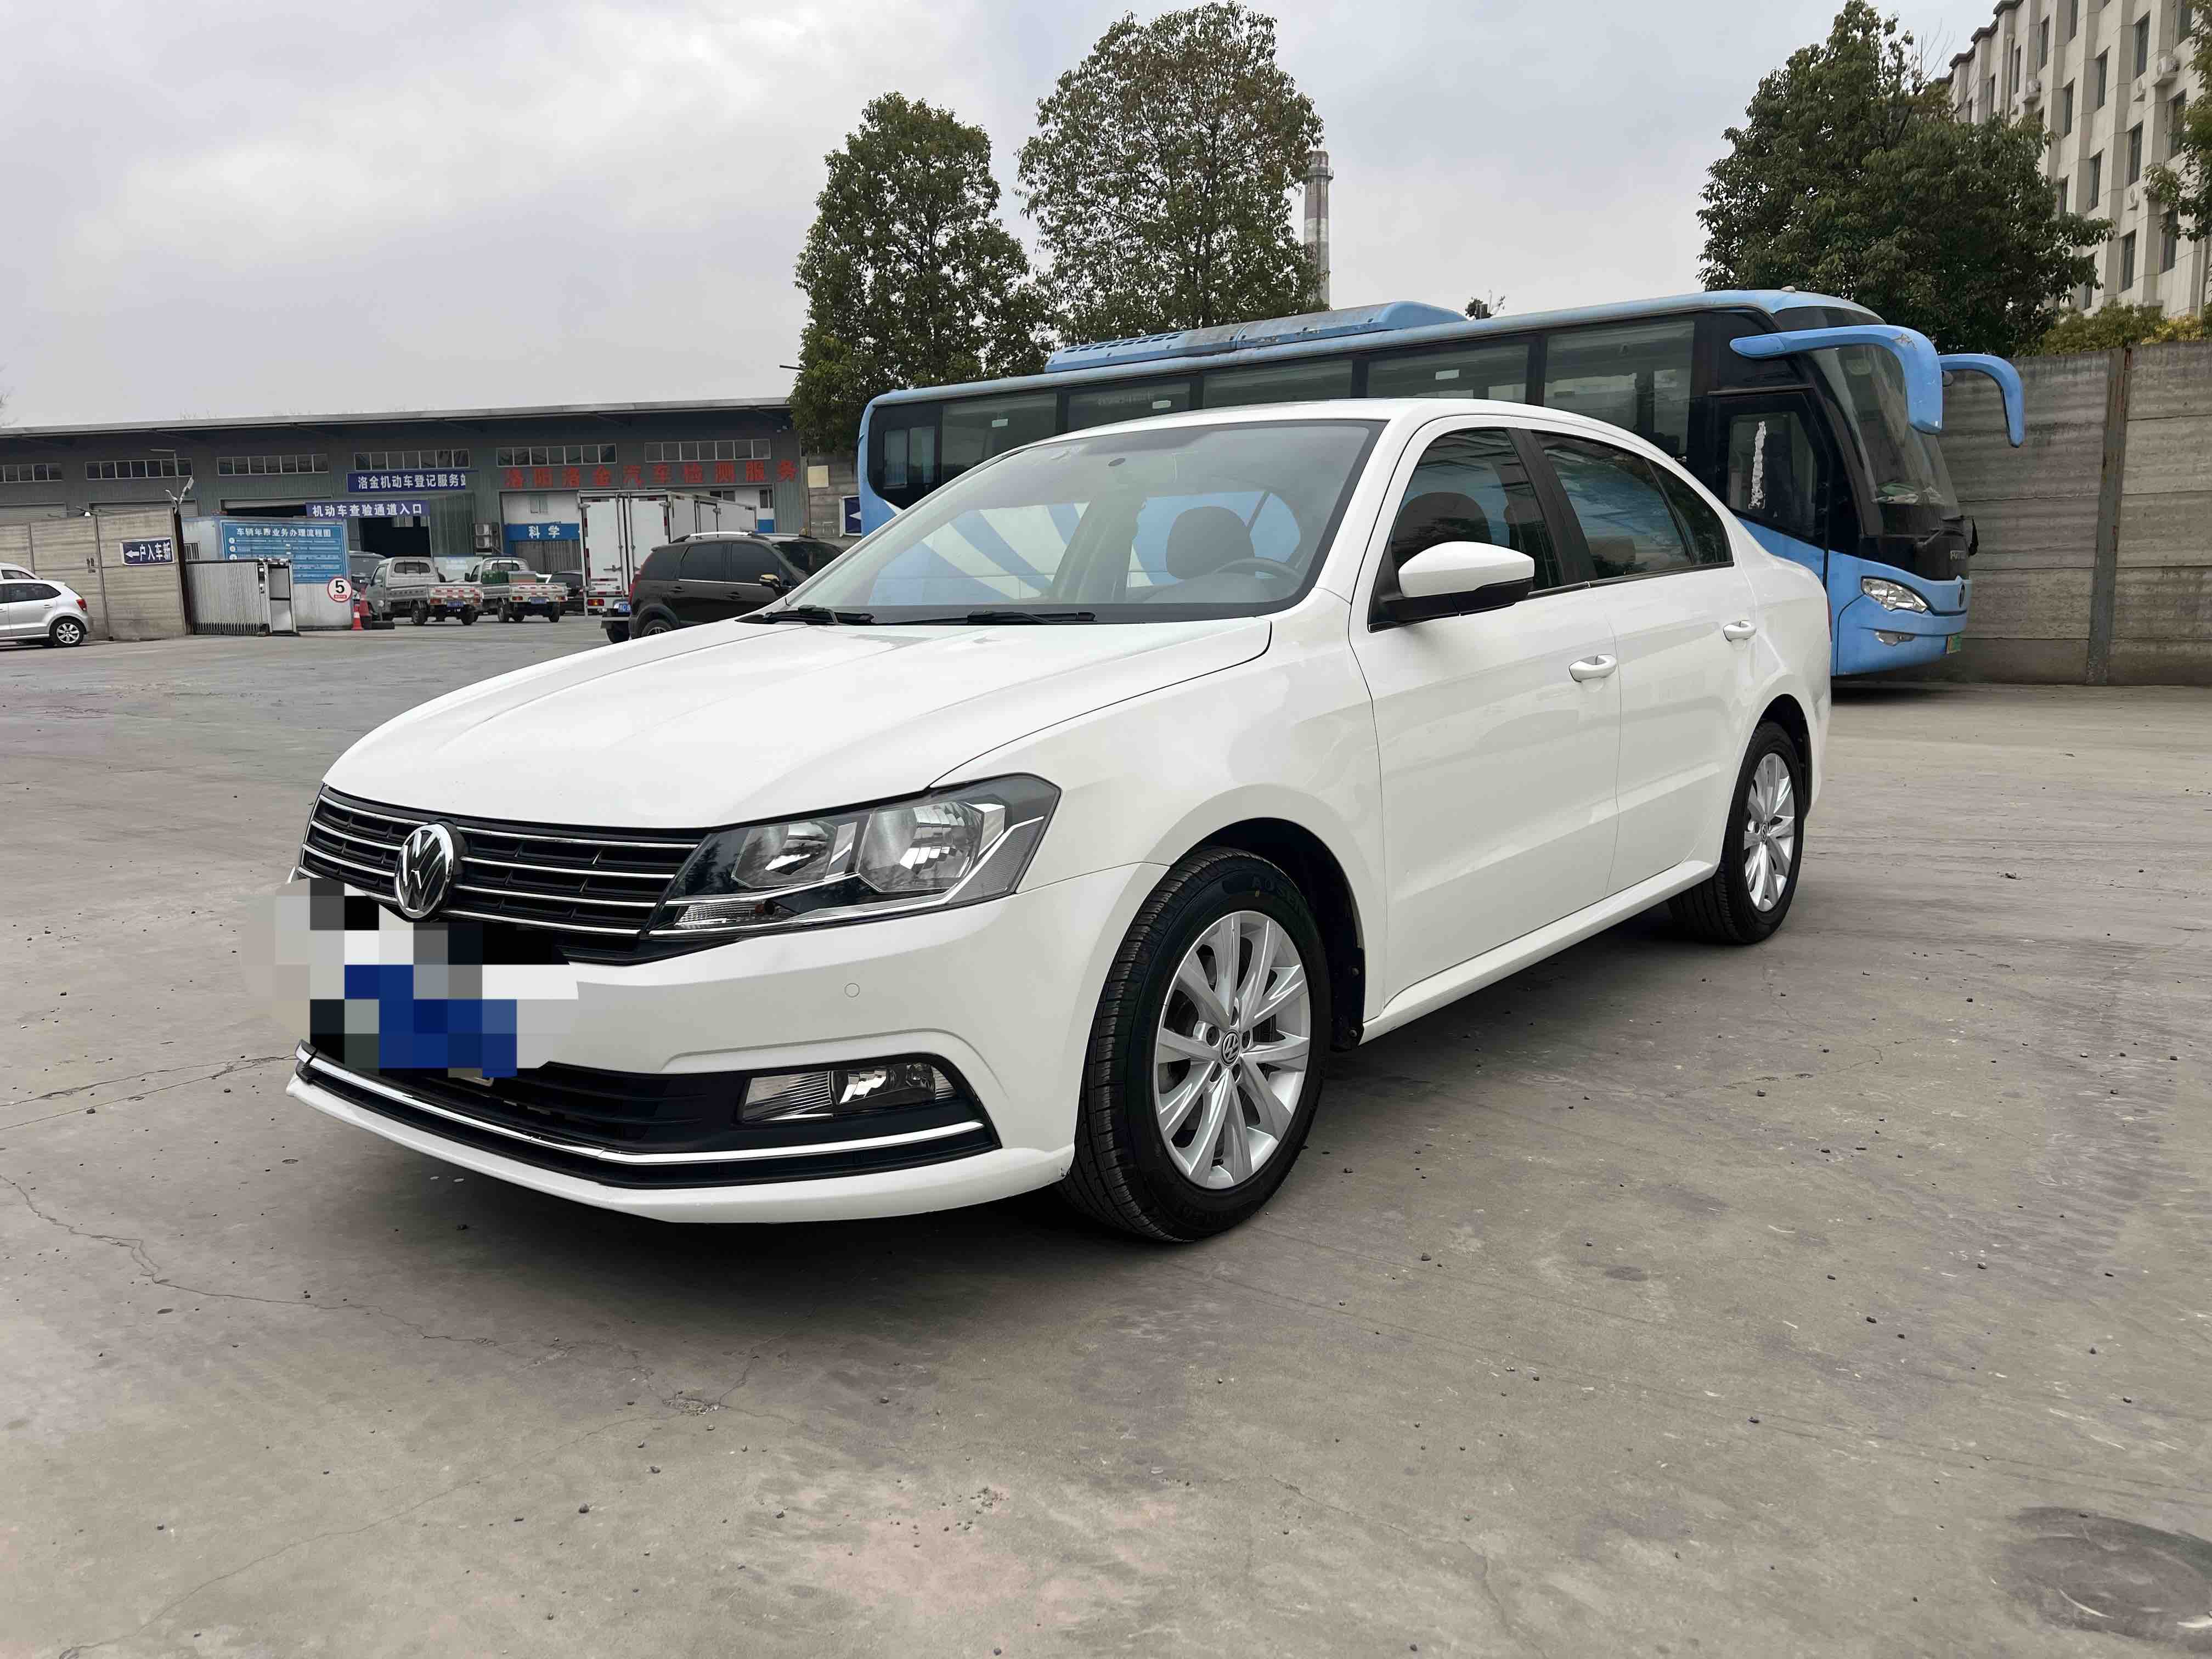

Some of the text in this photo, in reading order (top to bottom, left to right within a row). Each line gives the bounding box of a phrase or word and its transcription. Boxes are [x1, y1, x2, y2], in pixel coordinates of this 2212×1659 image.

[312, 503, 422, 517] 机动车查验通道入口
[335, 580, 346, 594] 5
